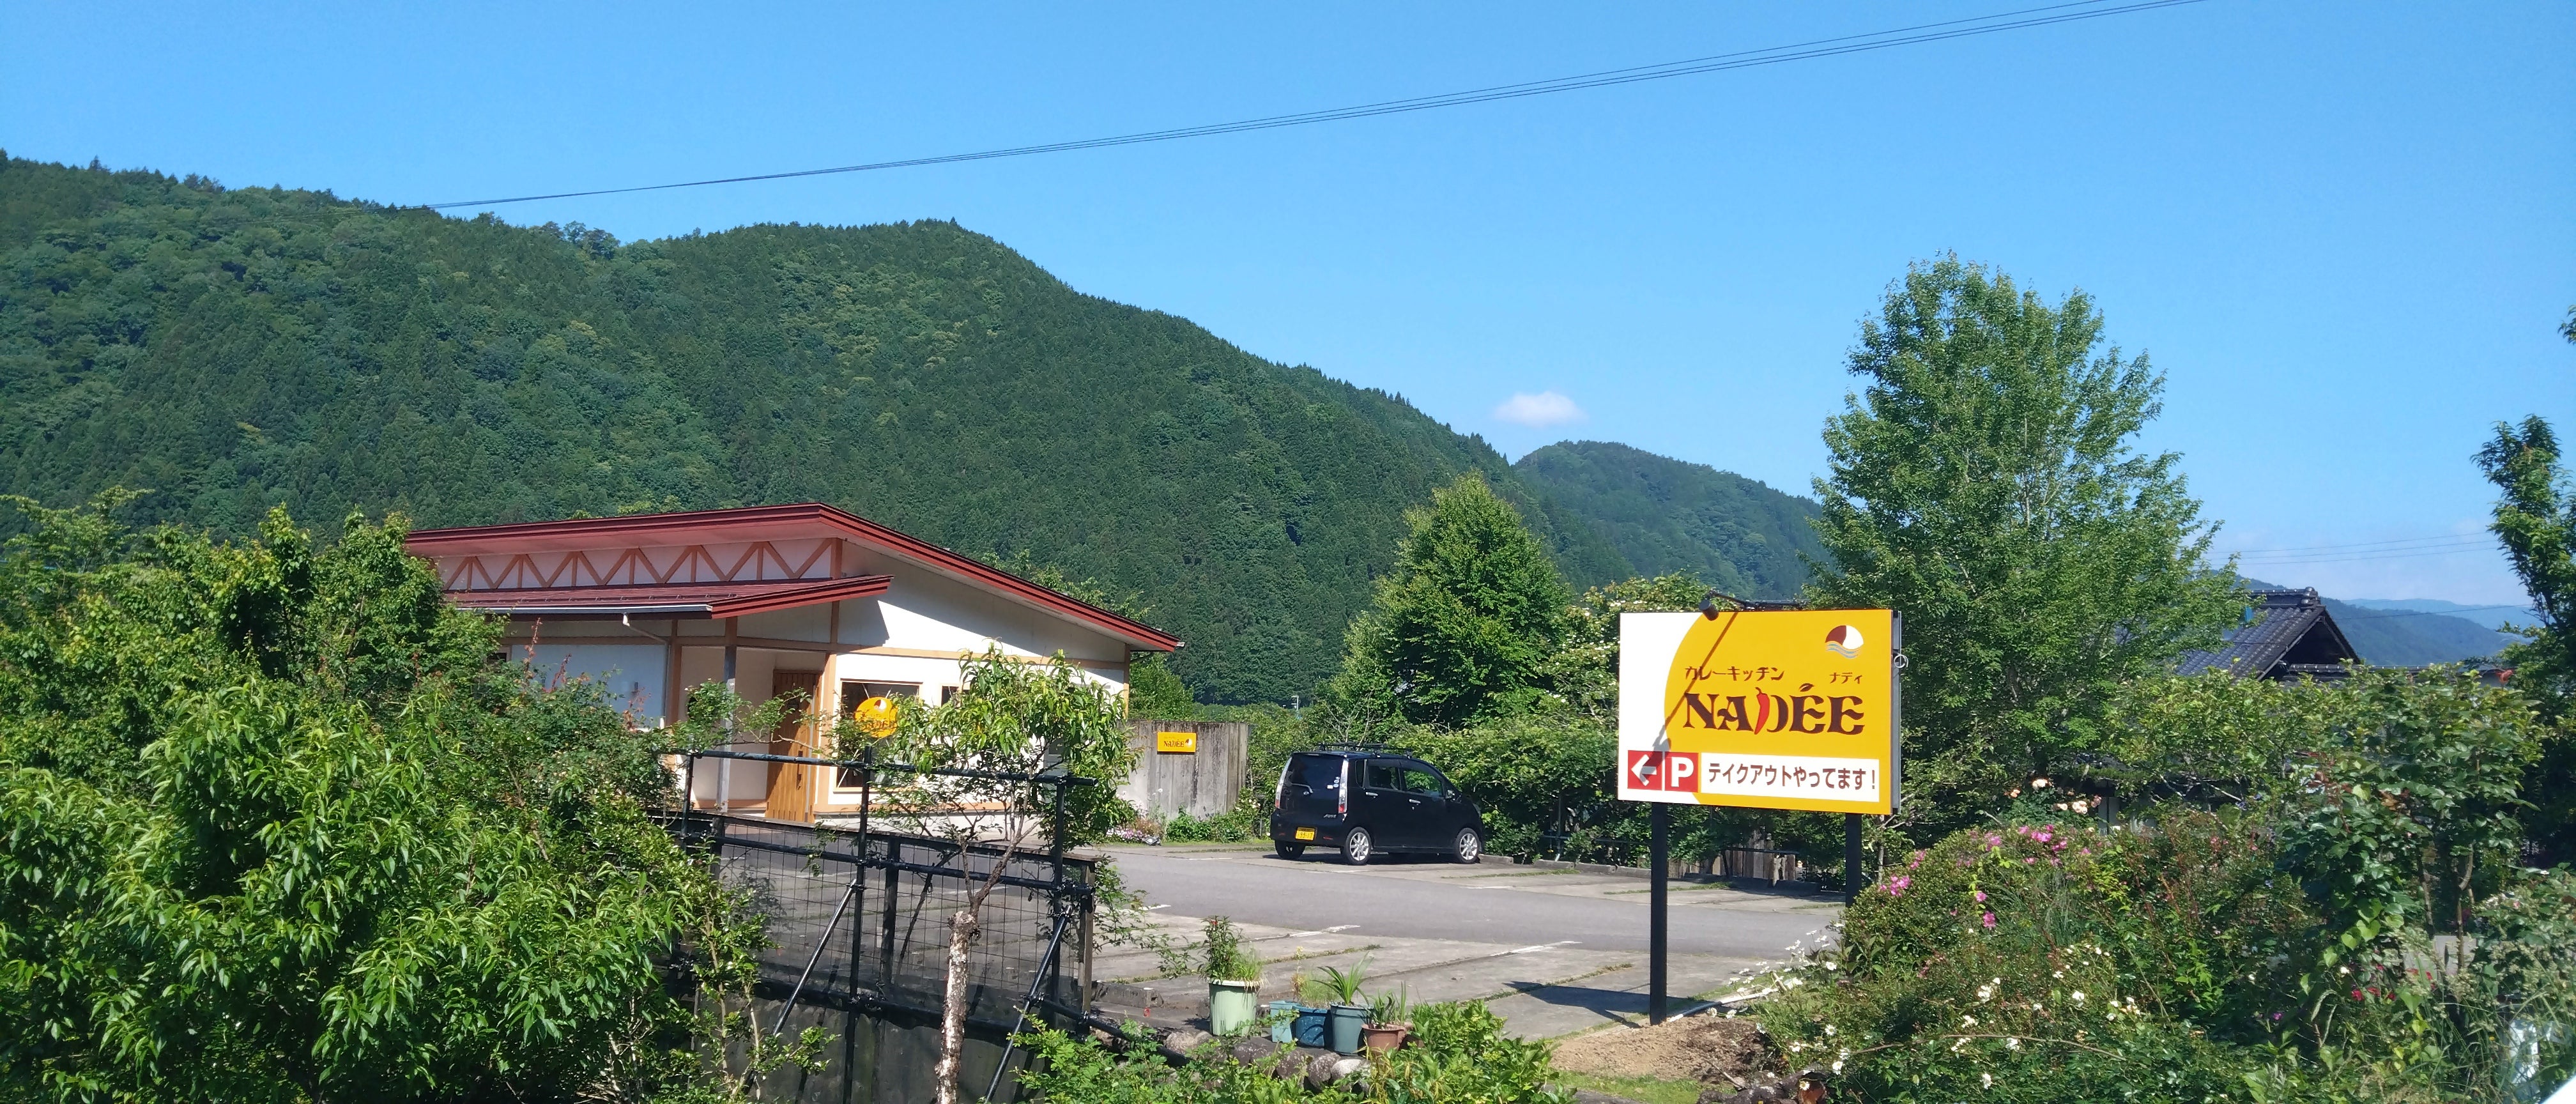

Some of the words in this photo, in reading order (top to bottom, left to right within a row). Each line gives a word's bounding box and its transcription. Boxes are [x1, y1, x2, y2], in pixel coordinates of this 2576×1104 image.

[1685, 666, 1784, 681] カレーキッチン
[1829, 672, 1862, 684] ナディ
[1671, 756, 1694, 787] P
